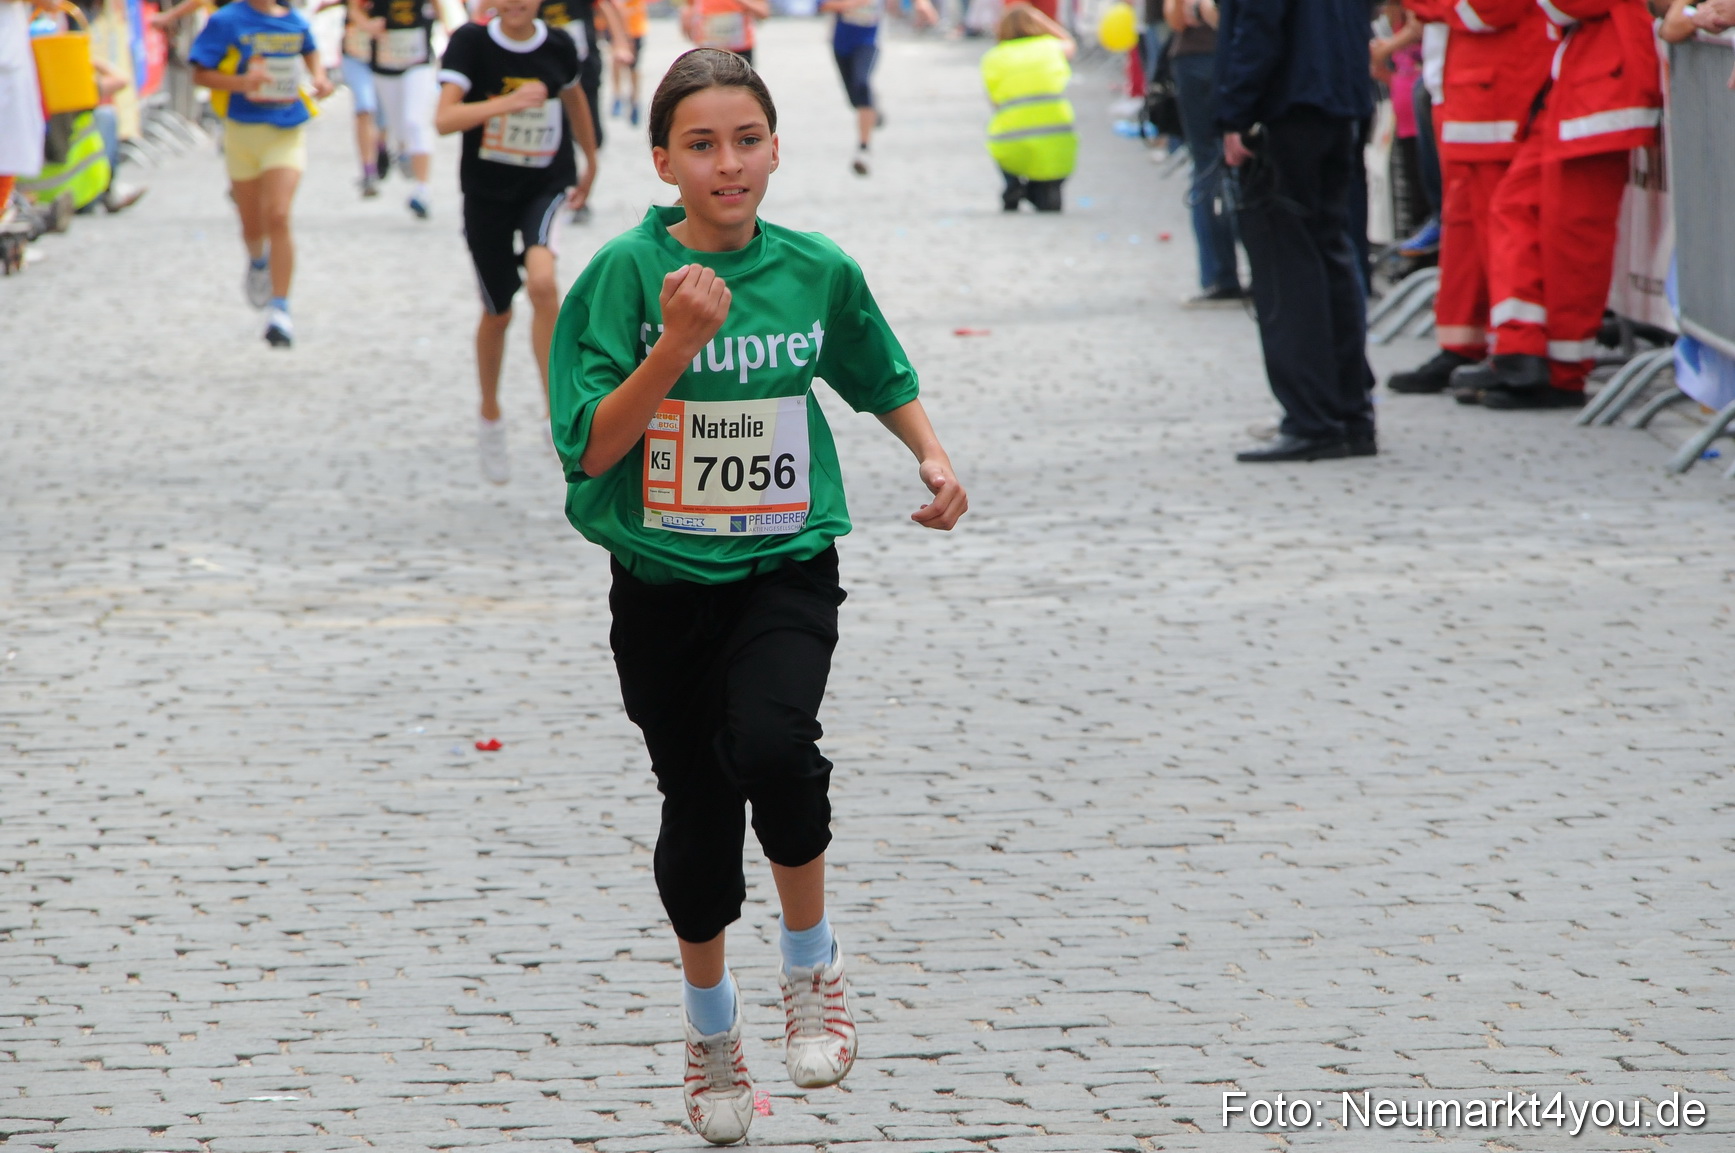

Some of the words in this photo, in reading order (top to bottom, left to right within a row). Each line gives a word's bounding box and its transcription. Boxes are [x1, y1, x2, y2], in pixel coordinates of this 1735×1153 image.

[508, 125, 555, 144] 7177
[692, 413, 764, 439] Natalie
[651, 450, 671, 470] K5
[693, 453, 796, 492] 7056
[748, 511, 807, 526] PFLEIDERER
